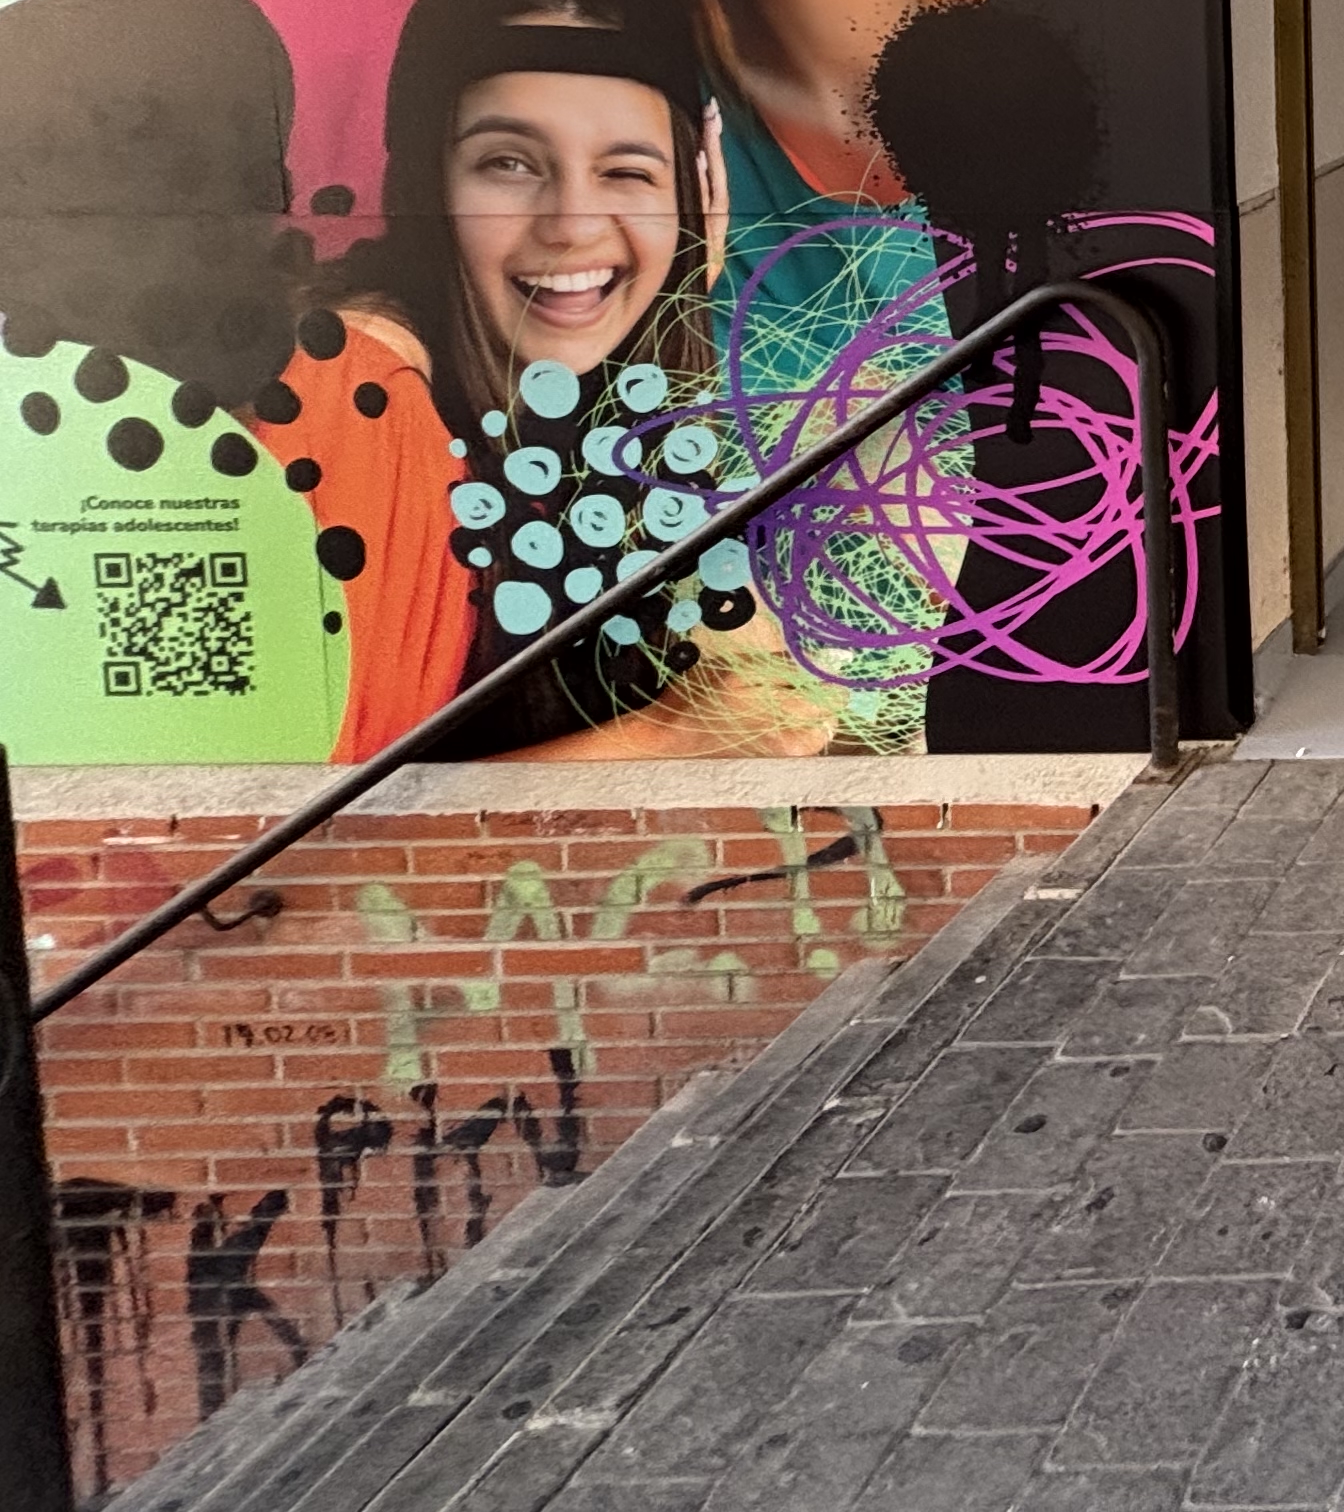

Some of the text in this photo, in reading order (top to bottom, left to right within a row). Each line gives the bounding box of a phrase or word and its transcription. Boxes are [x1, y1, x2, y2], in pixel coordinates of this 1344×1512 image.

[80, 495, 240, 513] ¡Conoce nuestras
[31, 517, 240, 534] terapias adolescentes!
